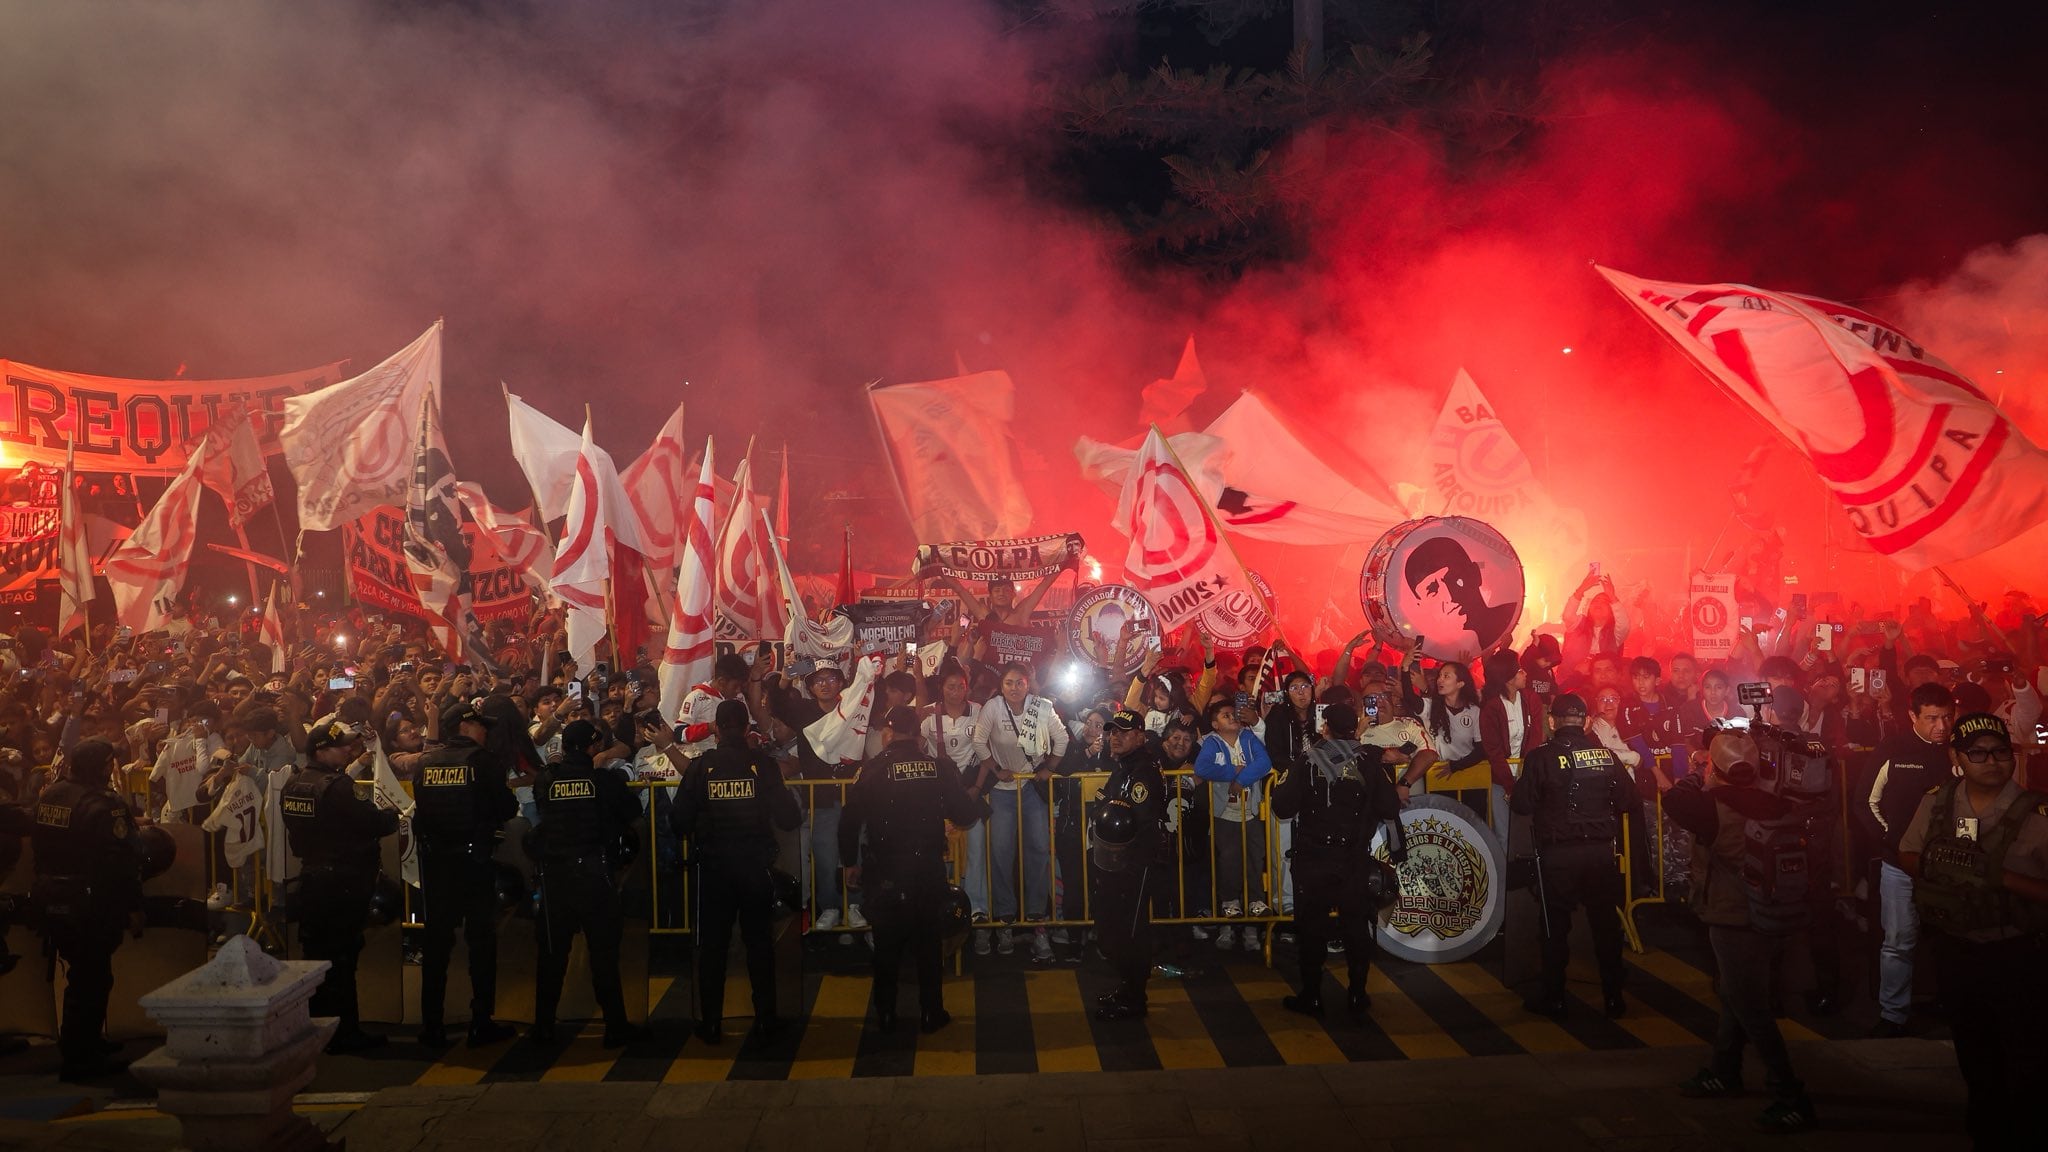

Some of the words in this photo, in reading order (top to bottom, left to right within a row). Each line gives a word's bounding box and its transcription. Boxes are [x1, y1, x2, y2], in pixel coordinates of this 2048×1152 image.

[950, 545, 1043, 571] CULPA
[972, 572, 999, 581] ESTE
[1959, 718, 2005, 738] POLICIA
[1575, 750, 1610, 761] POLICIA
[425, 768, 465, 784] POLICIA
[895, 763, 935, 774] POLICIA
[554, 782, 590, 797] POLICIA
[710, 781, 753, 798] POLICIA
[284, 800, 312, 812] POLICIA
[235, 806, 256, 843] 17
[1432, 835, 1444, 845] DE
[1444, 839, 1456, 851] LA
[1454, 849, 1472, 876] FIESTA
[1402, 896, 1461, 913] BANDA
[1463, 903, 1481, 919] 12
